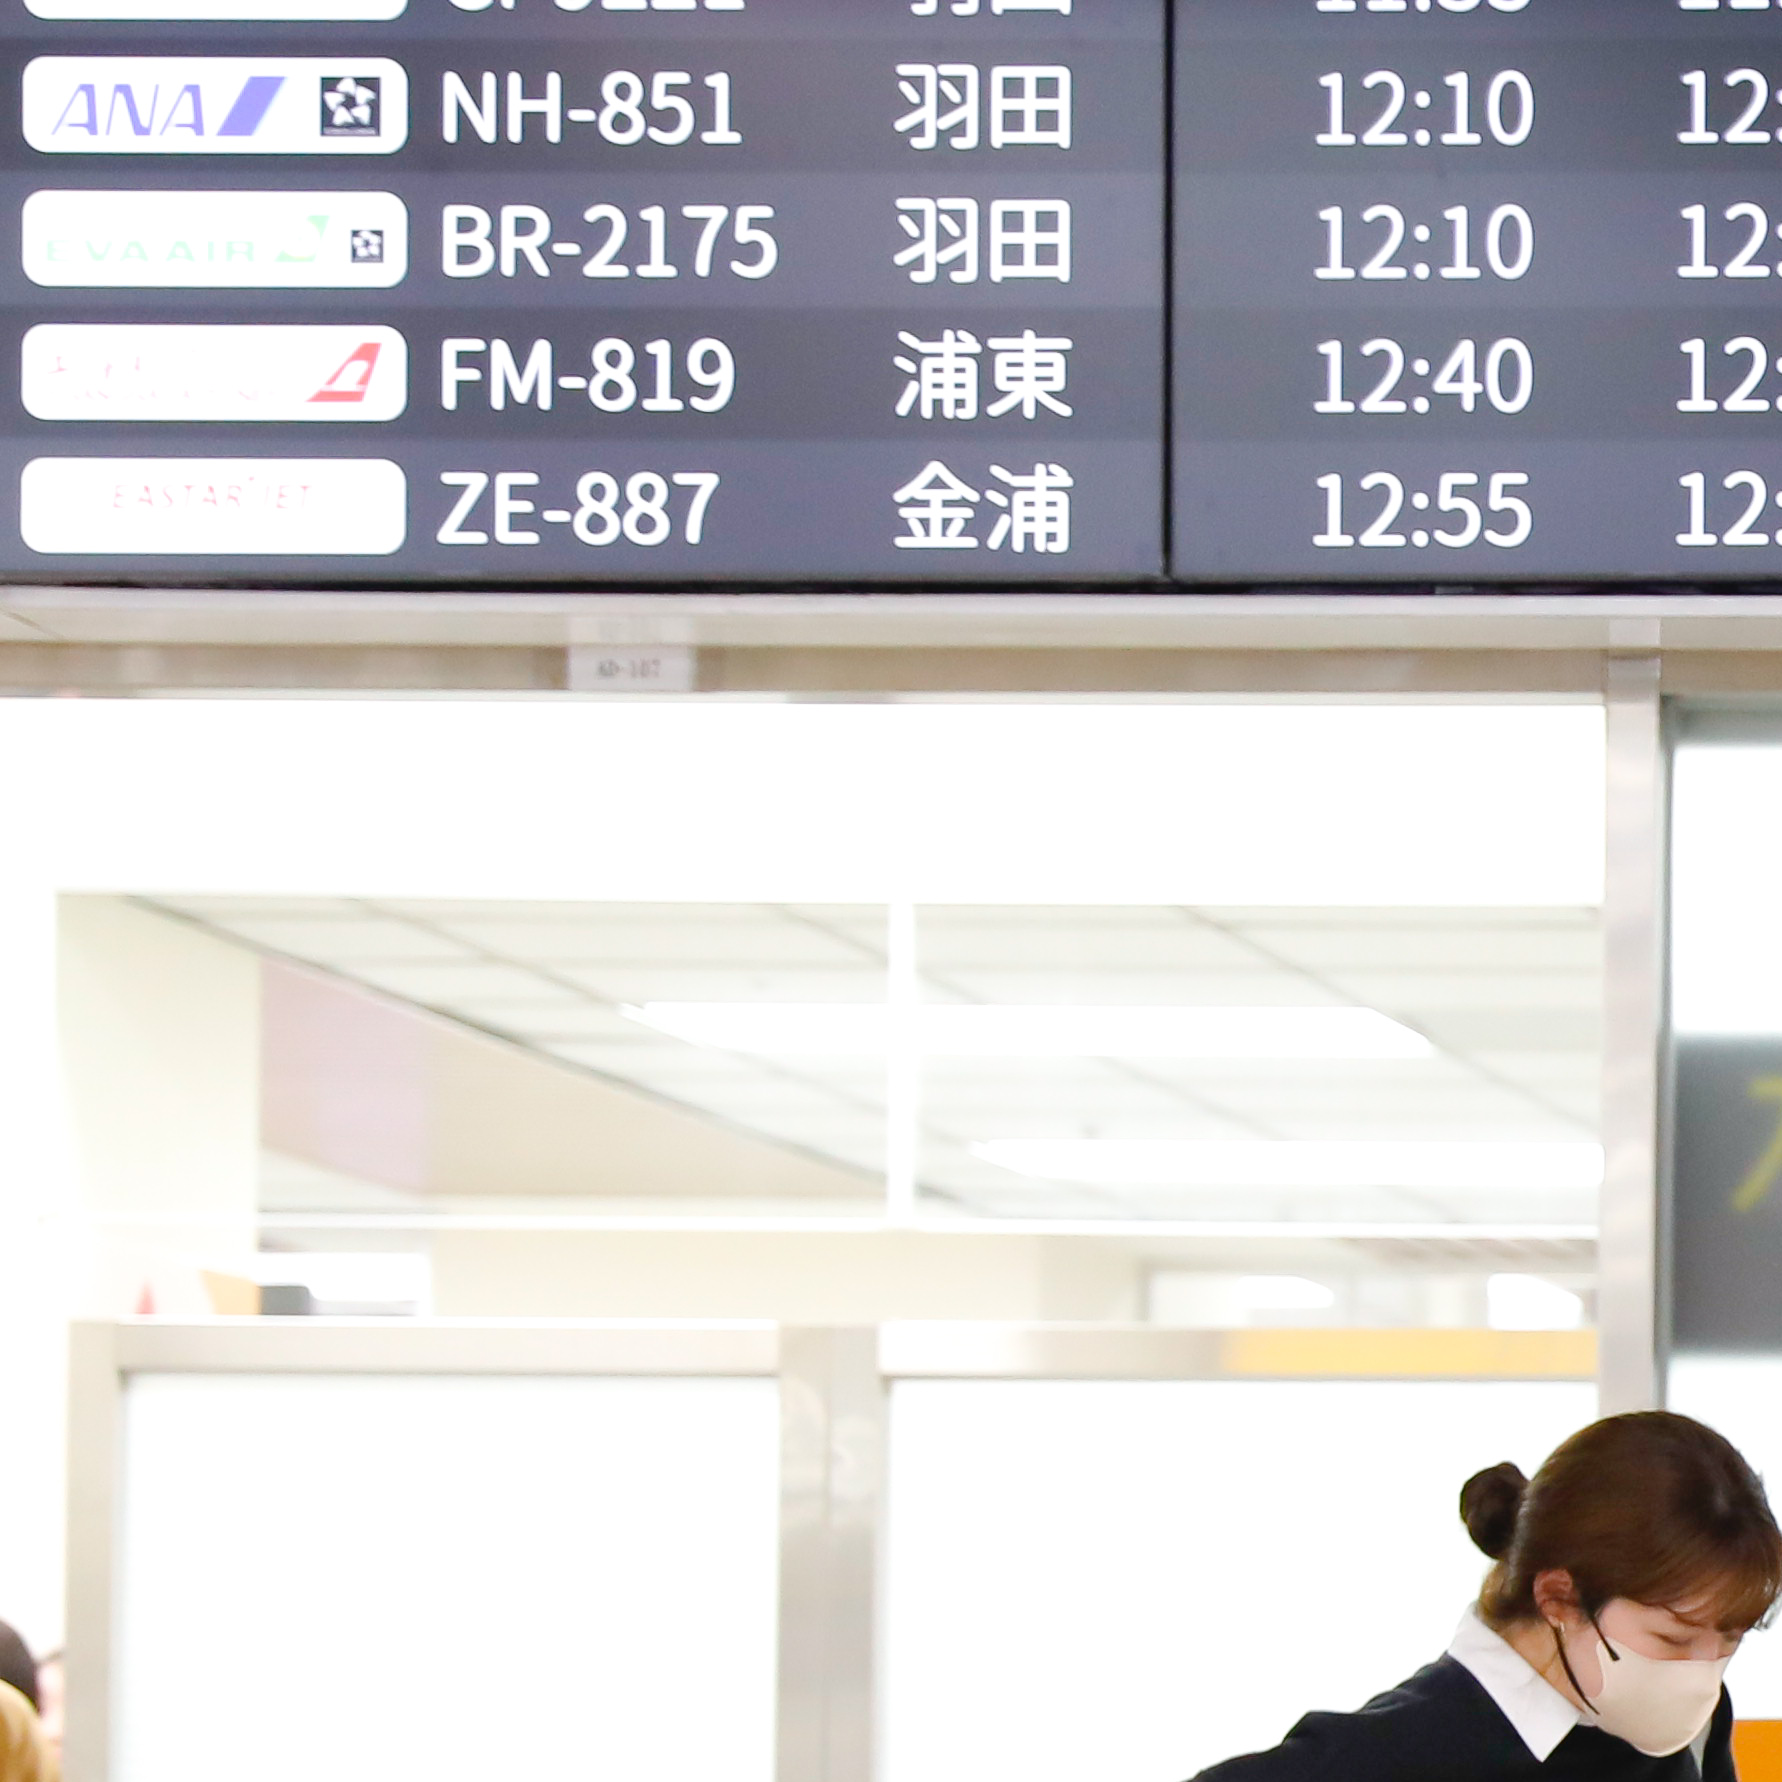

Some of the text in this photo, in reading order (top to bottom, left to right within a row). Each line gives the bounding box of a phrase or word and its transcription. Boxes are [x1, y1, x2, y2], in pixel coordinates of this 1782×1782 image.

[51, 83, 205, 136] ANA
[444, 72, 740, 144] NH-851
[895, 65, 1070, 148] 羽田
[1317, 71, 1532, 145] 12:10
[443, 205, 776, 277] BR-2175
[894, 198, 1070, 282] 羽田
[1316, 205, 1532, 278] 12:10
[443, 339, 733, 411] FM-819
[895, 330, 1071, 418] 浦東
[1315, 339, 1532, 412] 12:40
[438, 472, 718, 545] ZE-887
[894, 461, 1072, 552] 金浦
[1314, 473, 1531, 546] 12:55
